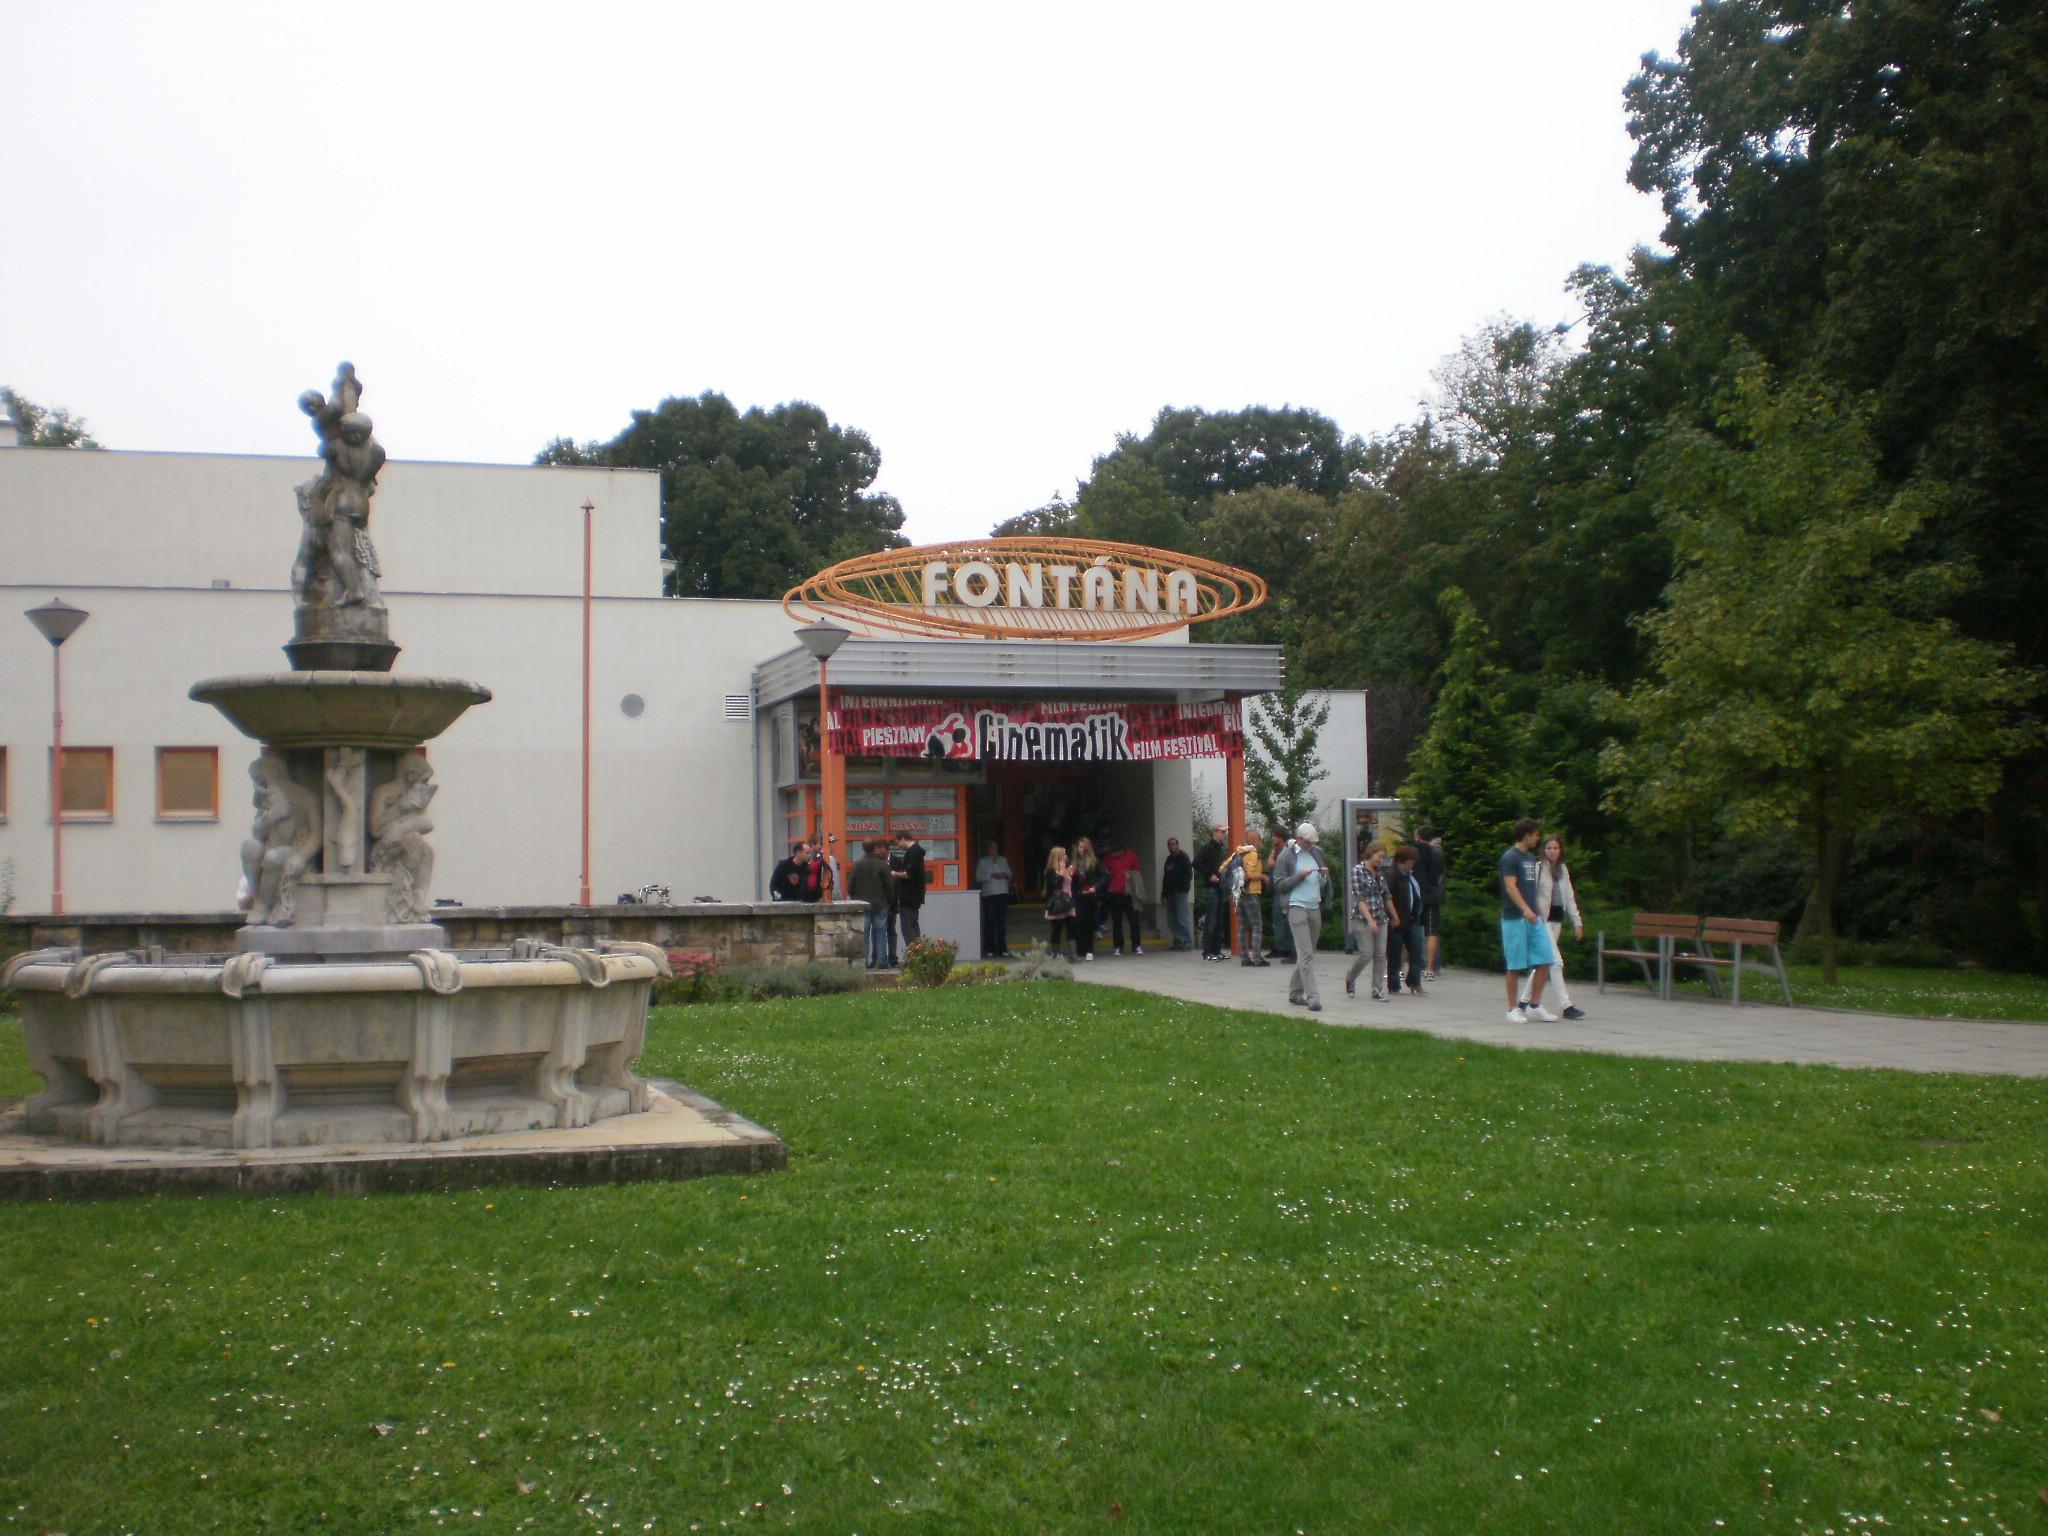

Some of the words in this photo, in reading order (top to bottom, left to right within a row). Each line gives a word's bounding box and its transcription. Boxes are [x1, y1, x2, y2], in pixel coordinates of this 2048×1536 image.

[922, 556, 1198, 614] FONTÁNA
[975, 709, 1132, 760] Cinematik
[1133, 740, 1161, 759] FILM
[1163, 734, 1218, 757] FESTIVAL
